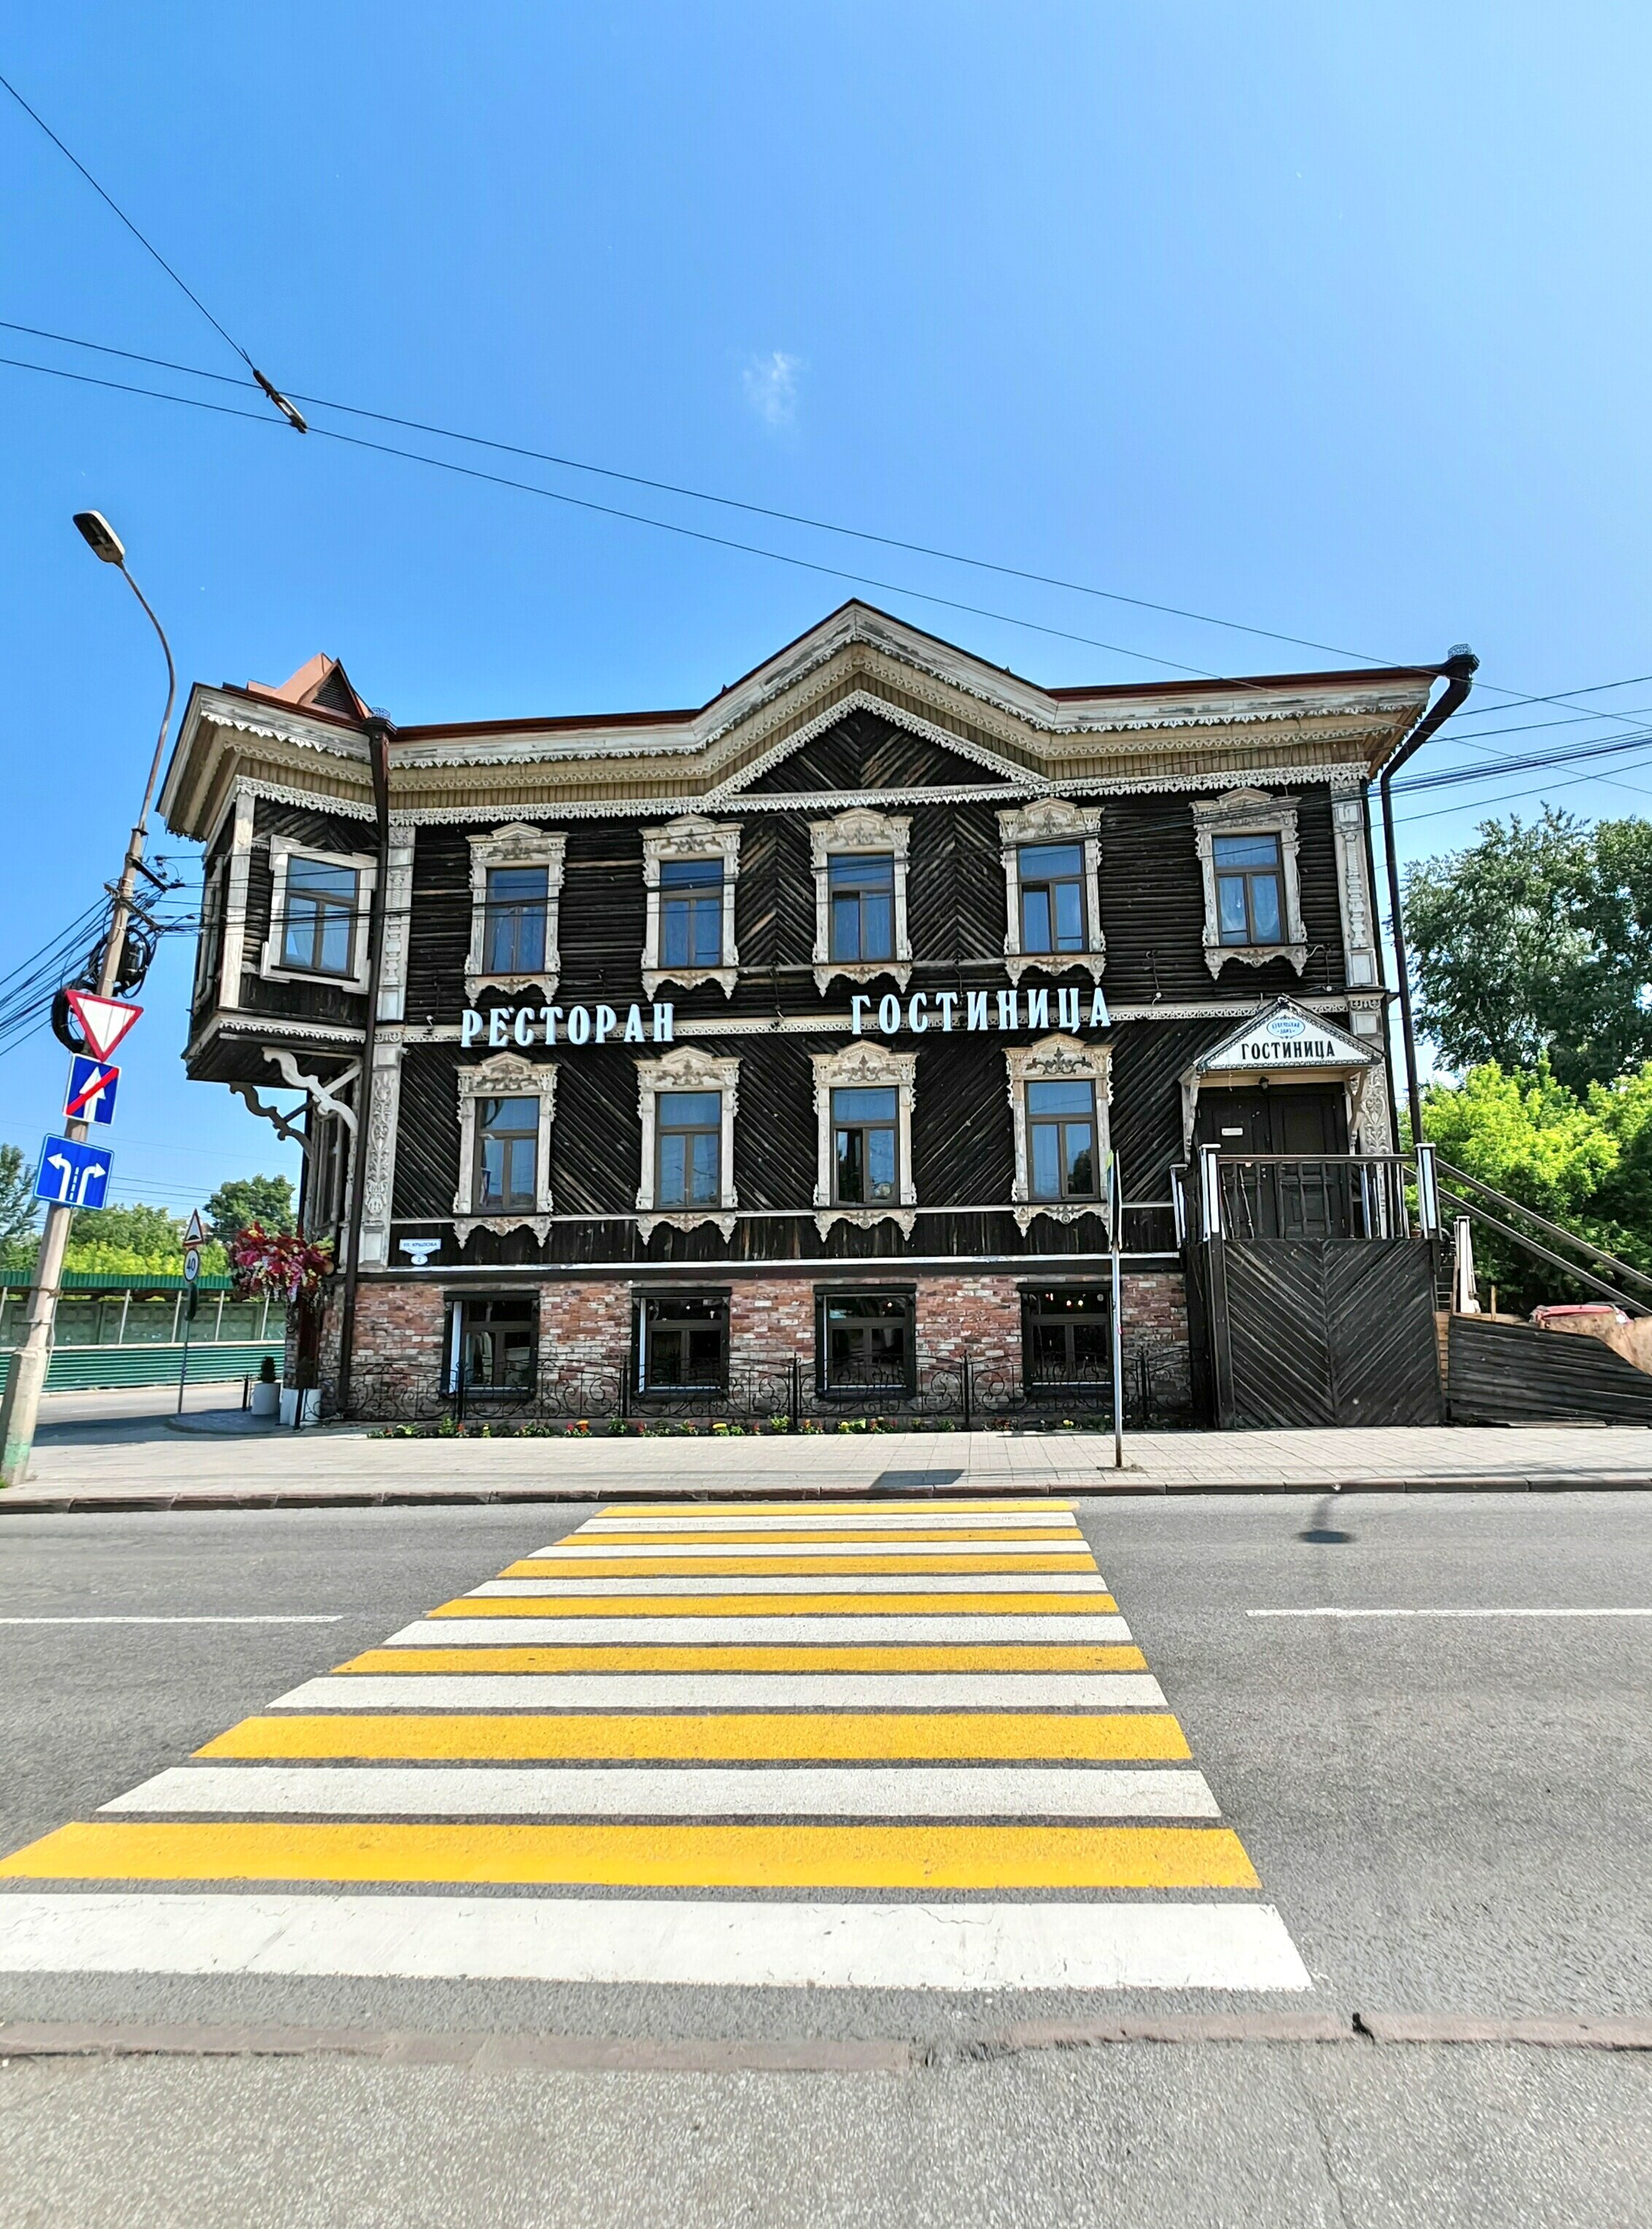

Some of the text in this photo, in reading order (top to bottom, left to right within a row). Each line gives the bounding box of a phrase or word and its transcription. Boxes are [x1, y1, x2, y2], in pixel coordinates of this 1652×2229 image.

[460, 1002, 674, 1047] РЕСТОРАН
[851, 987, 1111, 1034] ГОСТИНИЦА
[1241, 1040, 1335, 1060] ГОСТИНИЦА
[187, 1257, 196, 1272] 40
